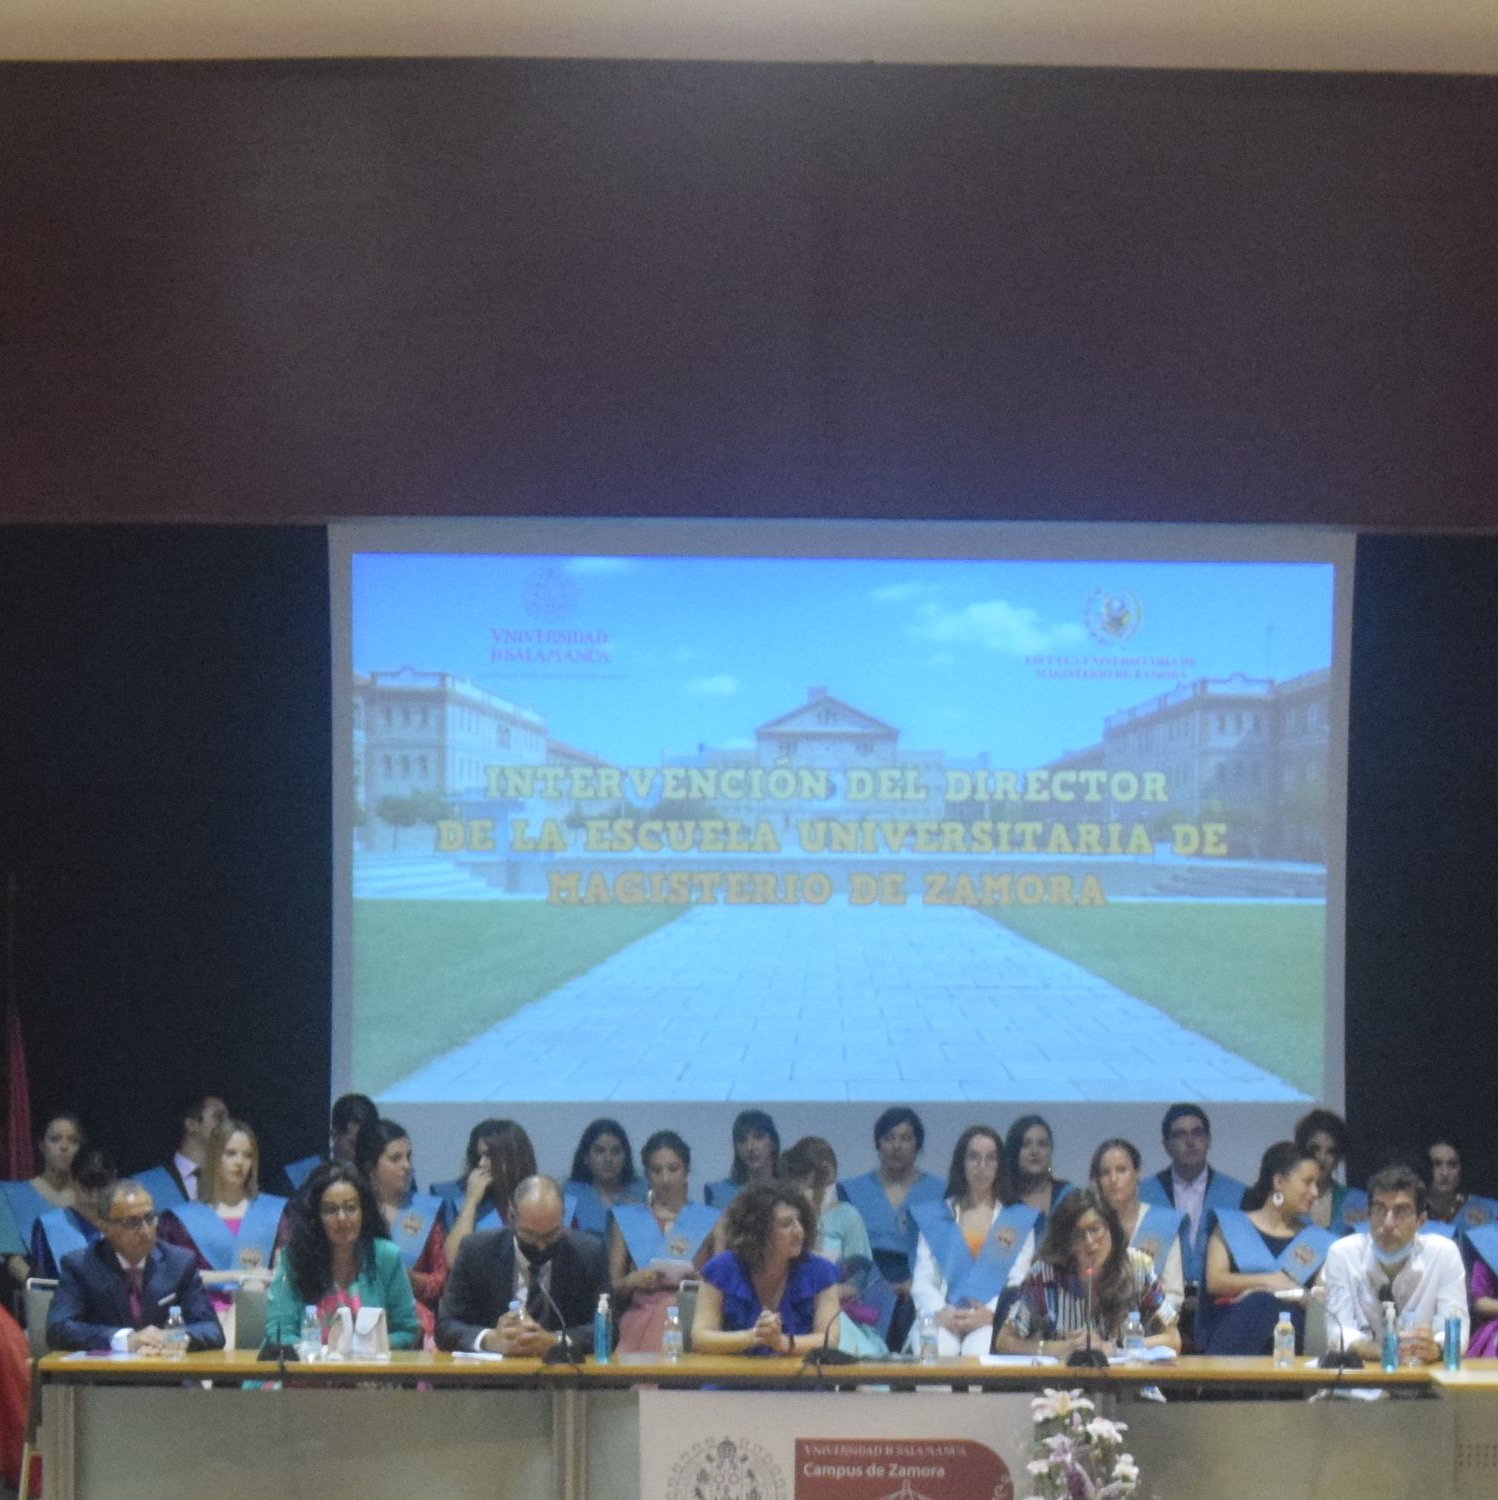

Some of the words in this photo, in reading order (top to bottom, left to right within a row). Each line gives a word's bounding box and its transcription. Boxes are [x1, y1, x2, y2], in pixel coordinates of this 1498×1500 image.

[485, 761, 829, 800] INTERVENCIÓN
[845, 768, 927, 801] DEL
[944, 769, 1170, 802] DIRECTOR
[436, 818, 497, 852] DE
[510, 818, 567, 852] LA
[584, 818, 781, 853] ESCUELA
[799, 820, 1156, 855] UNIVERSITARIA
[1171, 822, 1229, 856] DE
[547, 870, 834, 905] MAGISTERIO
[847, 871, 907, 905] DE
[921, 872, 1109, 906] ZAMORA
[803, 1462, 864, 1479] Campus
[866, 1462, 886, 1477] de
[888, 1462, 946, 1477] Zamora
